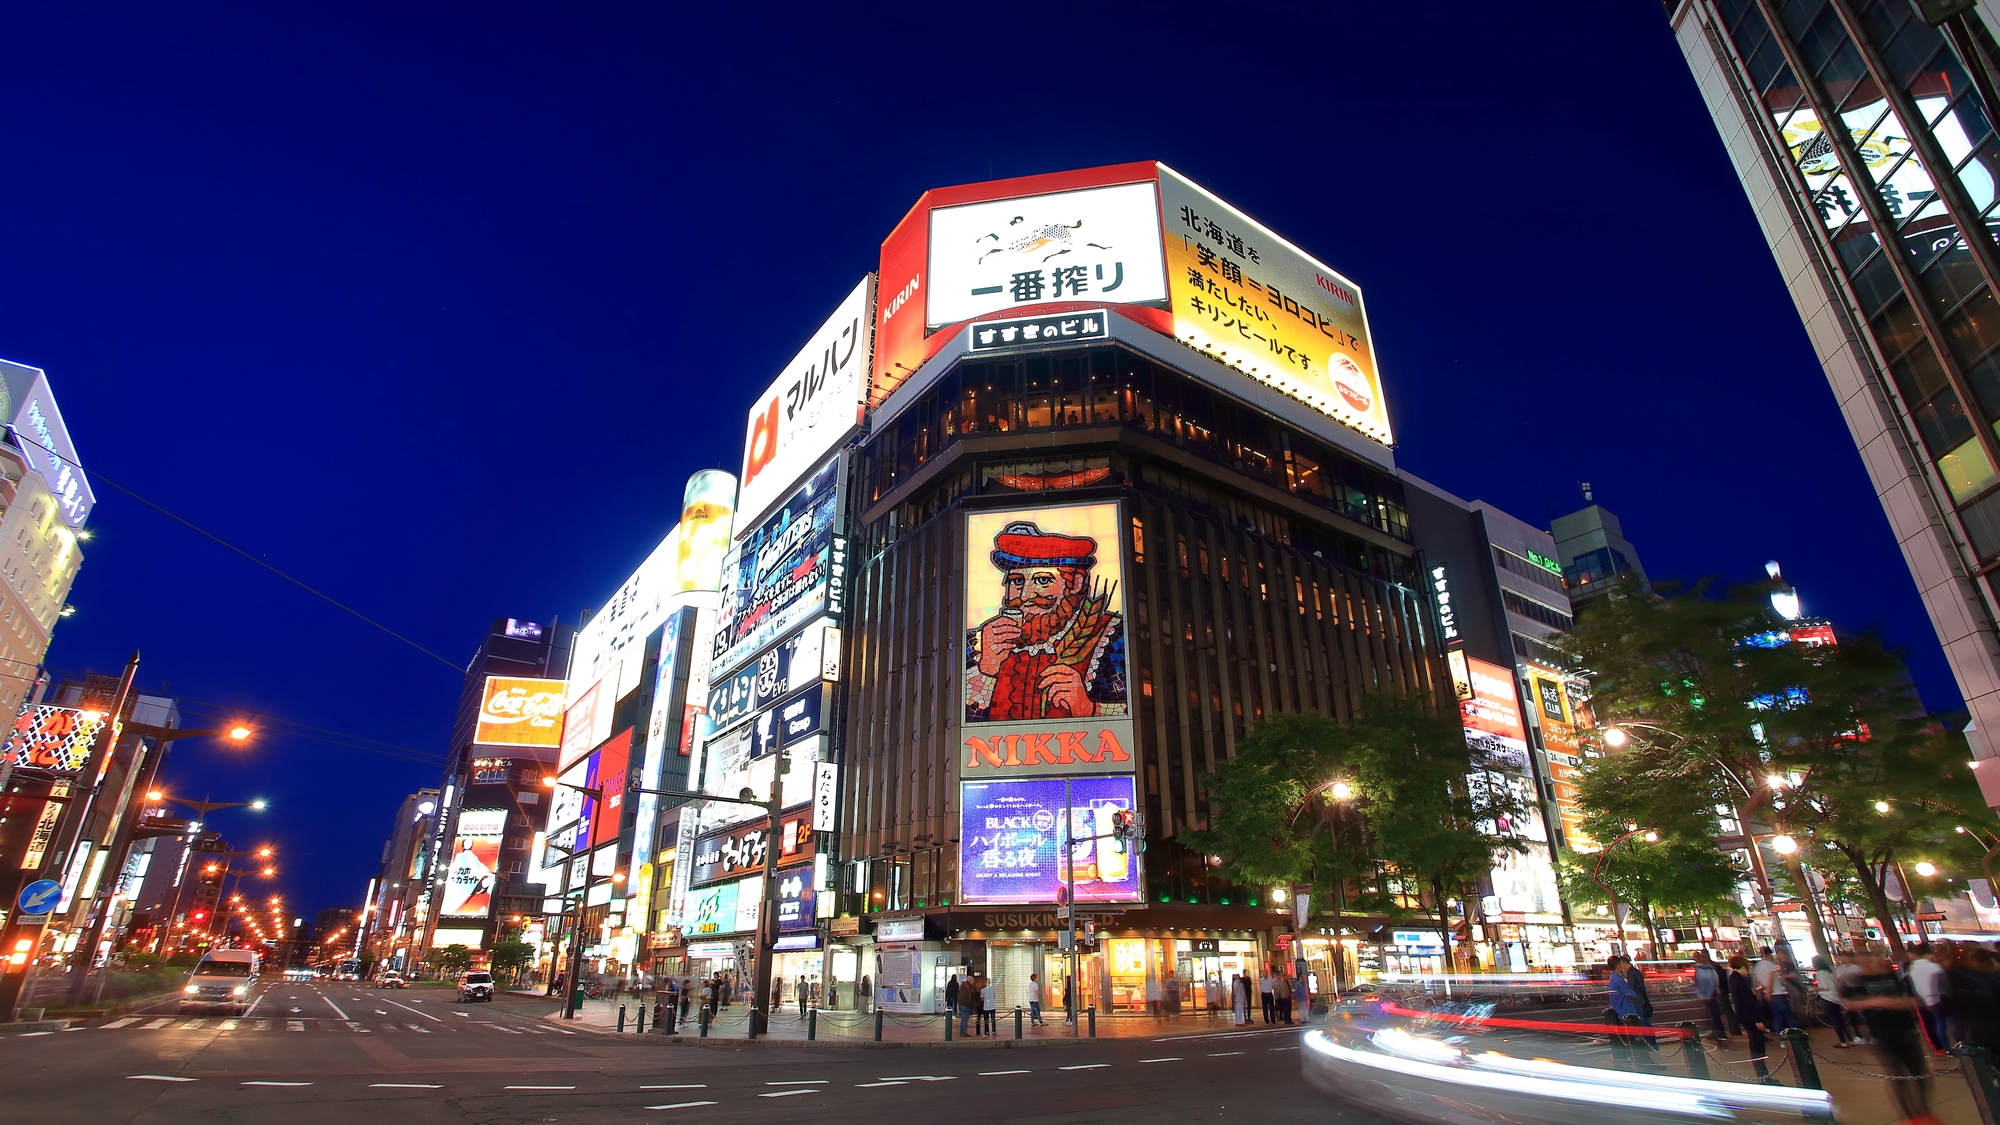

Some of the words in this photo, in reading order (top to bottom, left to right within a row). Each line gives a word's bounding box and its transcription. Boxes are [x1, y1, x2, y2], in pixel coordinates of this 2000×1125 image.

[1179, 204, 1260, 266] 北海道を
[883, 273, 921, 324] KIRIN
[971, 262, 1123, 302] 一番搾り
[1187, 267, 1278, 331] 満たしたい、
[1315, 272, 1355, 307] KIRIN
[978, 317, 1099, 345] すすきのビル
[1190, 296, 1319, 377] キリンビールです。
[787, 317, 858, 422] マルハン
[828, 537, 847, 614] すすきのビル
[1432, 566, 1458, 639] すすきのビル
[487, 690, 567, 717] Coca-Cola
[772, 679, 788, 698] EVE
[29, 711, 75, 764] かに
[965, 729, 1131, 768] NIKKA
[463, 823, 499, 832] docomo
[798, 823, 811, 844] 2F
[969, 832, 1048, 849] ハイボール
[985, 816, 1032, 830] BLACK
[980, 849, 1038, 869] 香る夜
